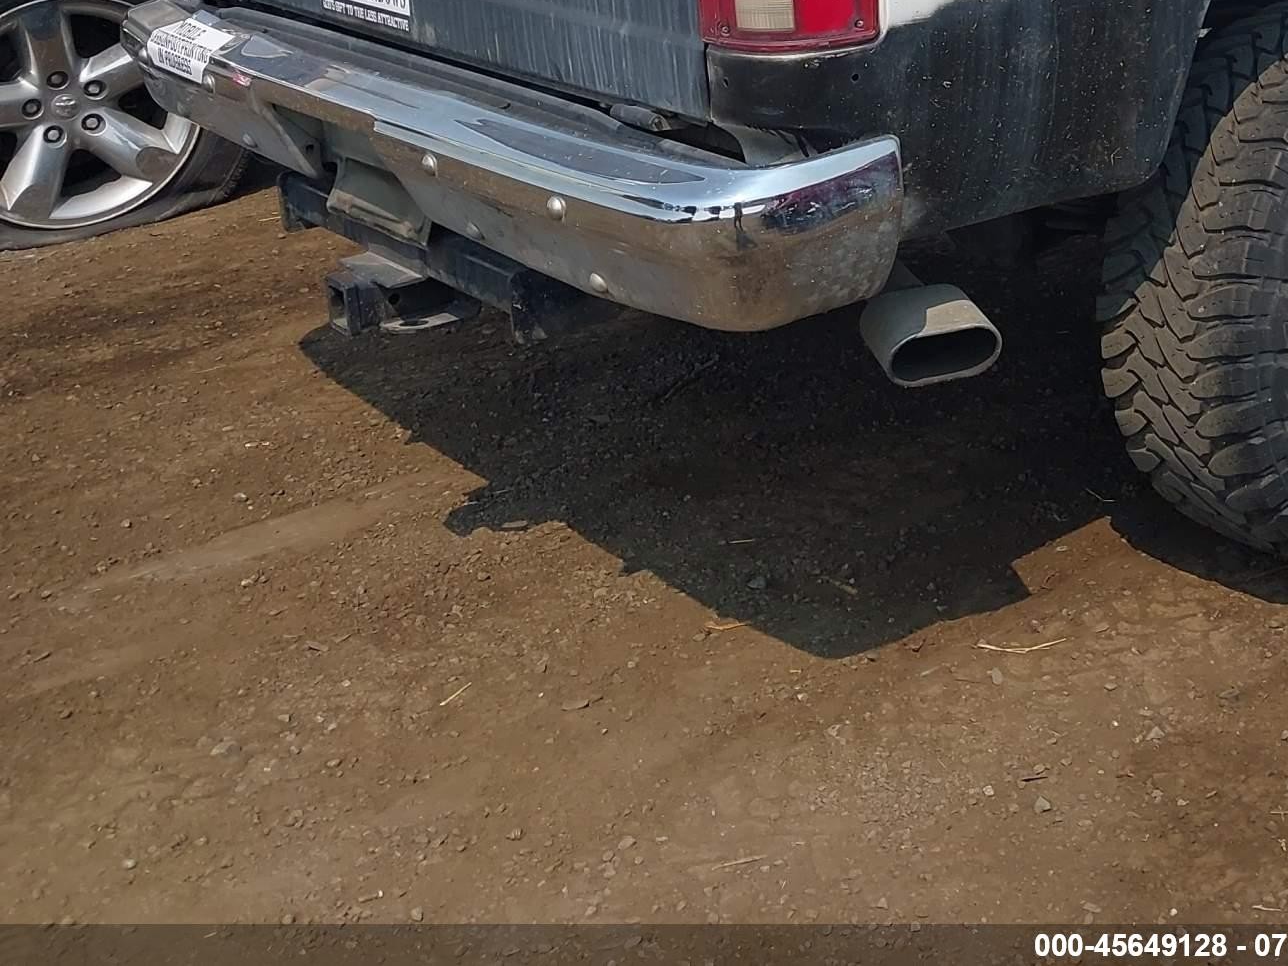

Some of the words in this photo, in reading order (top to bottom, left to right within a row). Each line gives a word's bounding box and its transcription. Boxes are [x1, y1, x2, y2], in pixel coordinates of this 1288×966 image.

[345, 3, 354, 16] TO
[353, 5, 365, 20] THE
[365, 8, 378, 23] LESS
[377, 11, 410, 32] ATTRACTIVE
